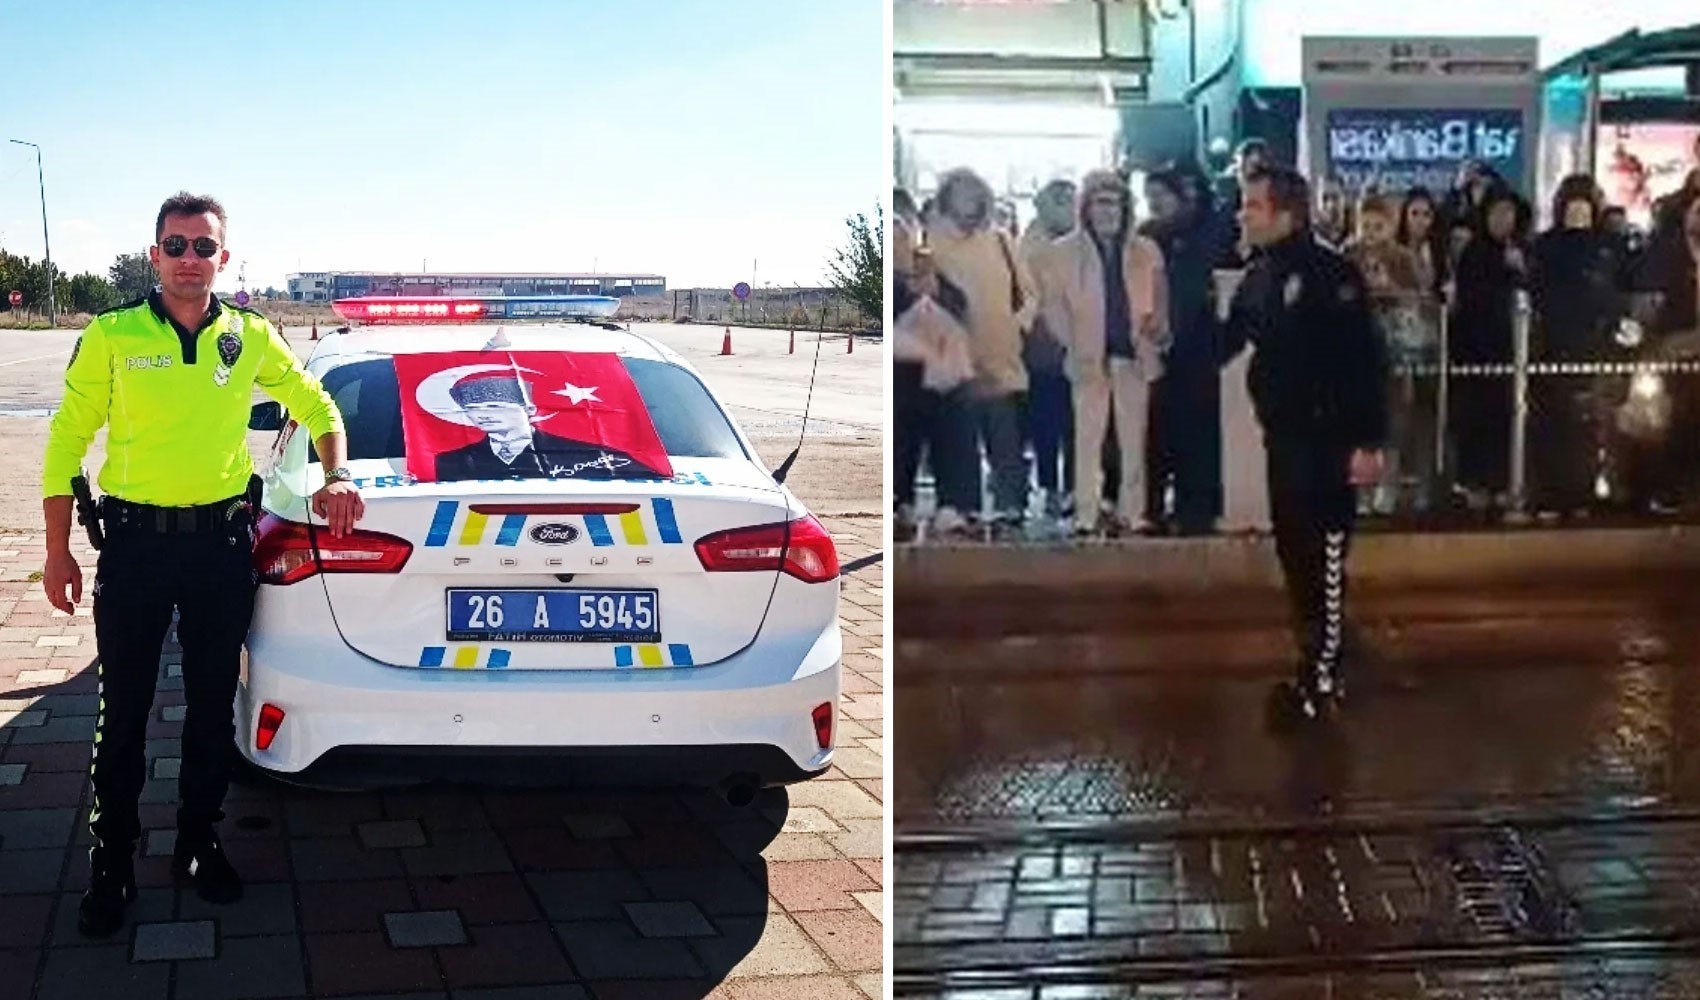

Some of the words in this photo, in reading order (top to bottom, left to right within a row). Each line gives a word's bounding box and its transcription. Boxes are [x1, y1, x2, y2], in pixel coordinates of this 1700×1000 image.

[539, 526, 569, 539] Ford
[453, 556, 654, 566] FOCUS
[468, 595, 504, 628] 26
[533, 595, 549, 628] A
[579, 595, 652, 629] 5945
